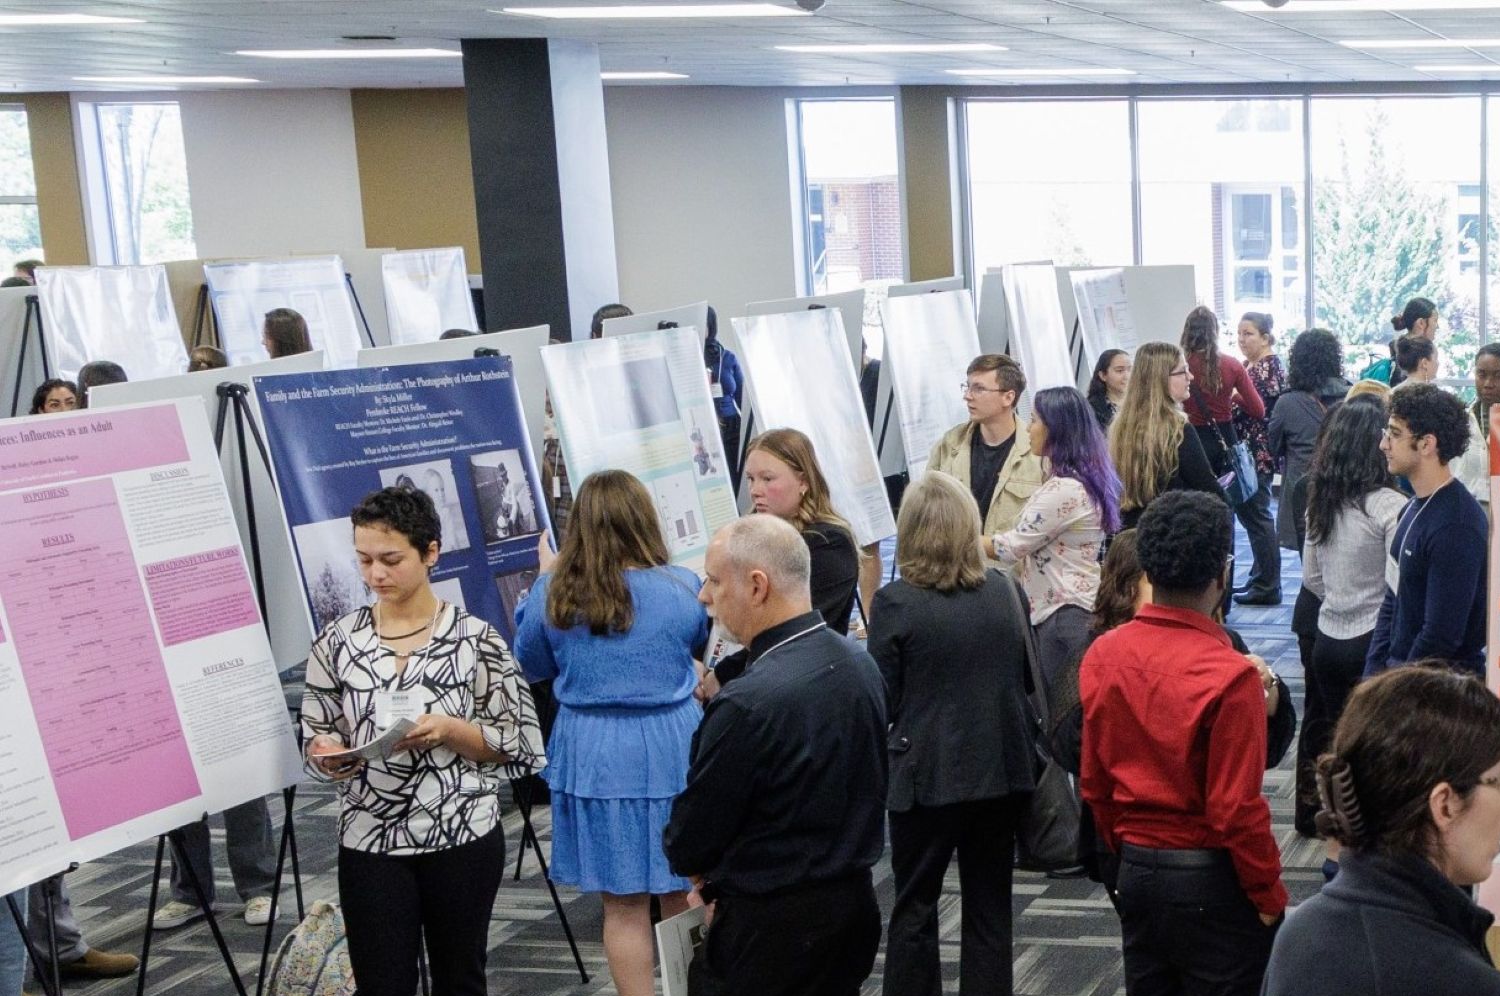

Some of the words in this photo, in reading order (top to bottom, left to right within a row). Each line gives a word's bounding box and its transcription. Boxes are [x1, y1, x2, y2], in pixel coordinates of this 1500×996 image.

[265, 390, 288, 403] Family
[288, 389, 301, 399] and
[301, 388, 312, 399] the
[313, 387, 329, 398] Farm
[330, 385, 355, 397] Security
[356, 381, 402, 394] Administration:
[402, 378, 417, 389] The
[417, 374, 454, 389] Photography
[454, 373, 460, 384] of
[461, 372, 482, 383] Arthur
[397, 393, 412, 402] Miller
[390, 405, 409, 414] REACH
[410, 403, 427, 412] Fellow
[20, 430, 66, 443] Influences
[67, 428, 76, 436] as
[78, 426, 89, 435] an
[90, 421, 113, 433] Adult
[364, 446, 377, 455] What
[389, 444, 401, 452] Farm
[401, 442, 419, 452] Security
[22, 487, 70, 504] HYPOTHESIS
[41, 533, 75, 547] RESULTS
[202, 657, 245, 676] REFERENCES
